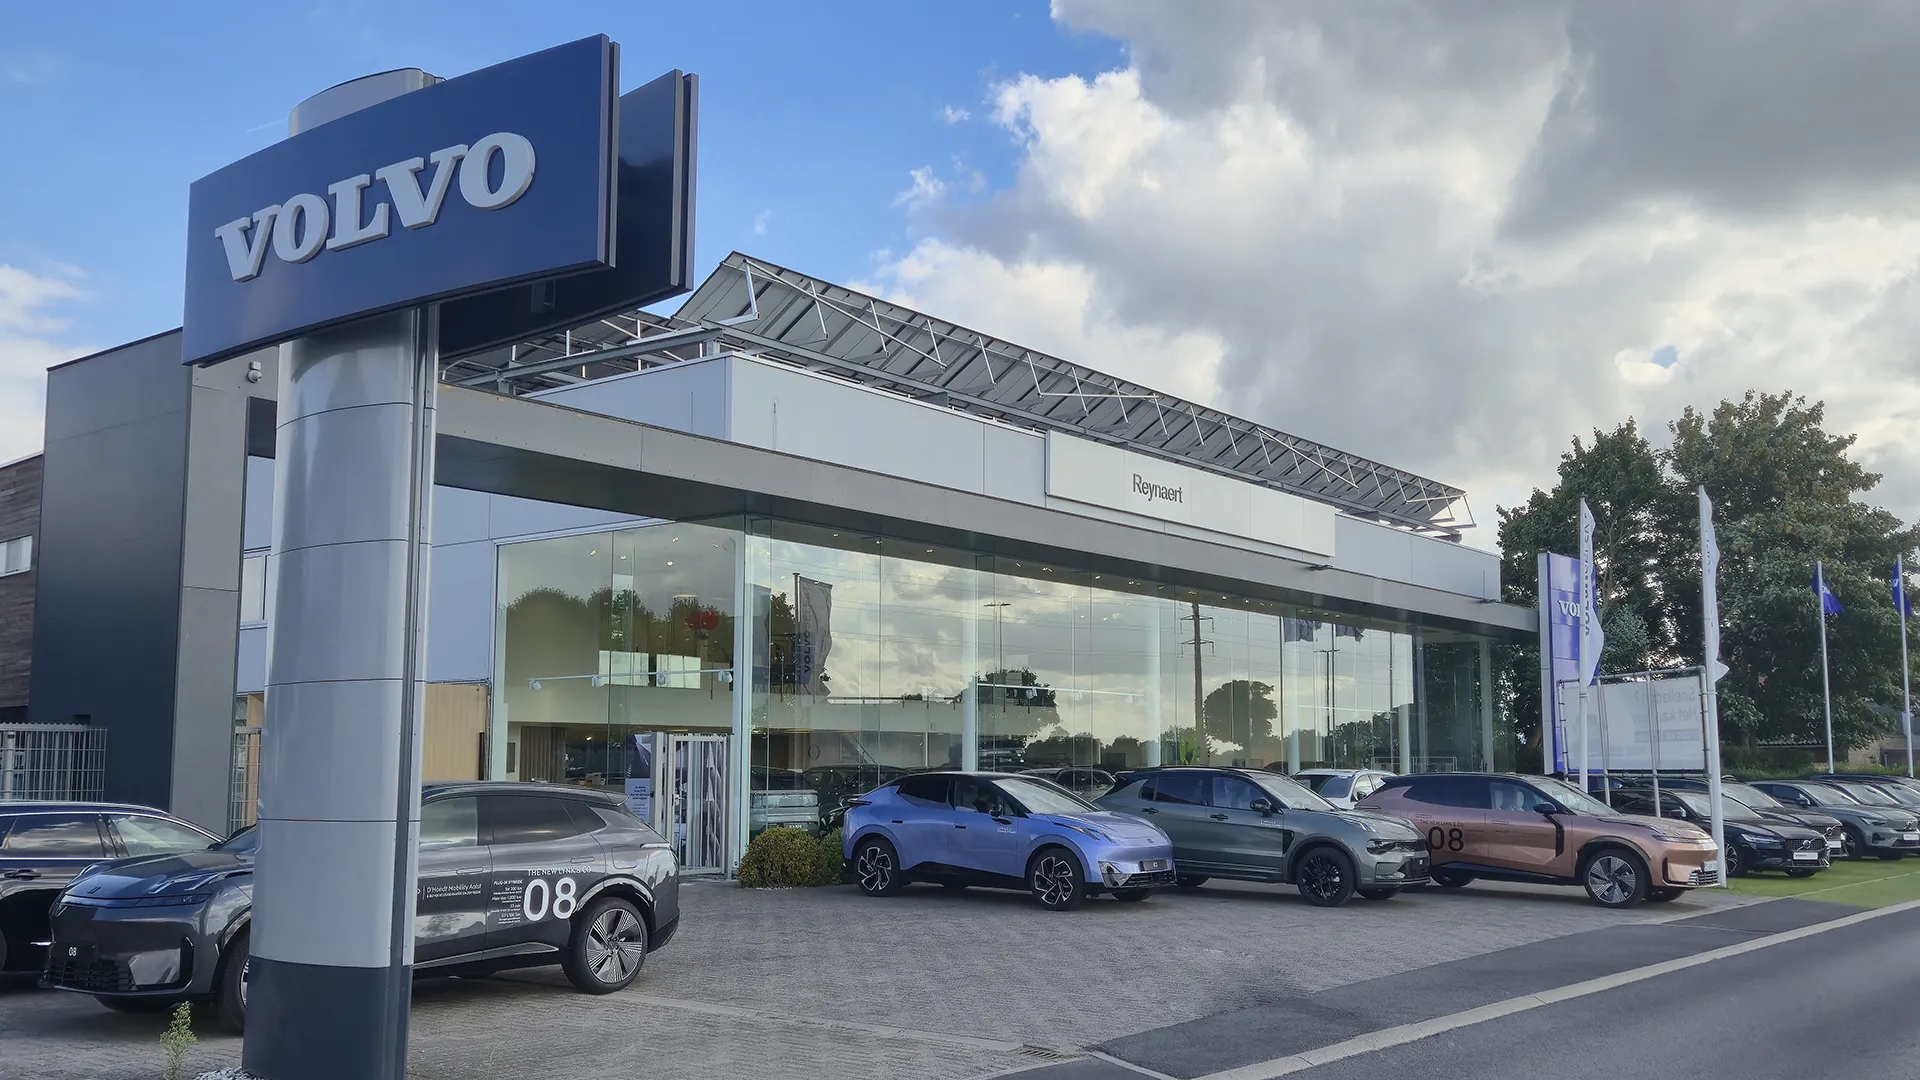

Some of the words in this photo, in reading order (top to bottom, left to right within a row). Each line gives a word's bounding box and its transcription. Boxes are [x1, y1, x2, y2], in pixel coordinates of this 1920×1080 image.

[214, 131, 536, 283] VOLVO
[1132, 473, 1183, 504] Reynaert
[1428, 826, 1464, 852] 08
[528, 869, 541, 877] THE
[541, 868, 558, 876] NEW
[558, 867, 575, 875] LYNK
[523, 877, 577, 922] 08
[68, 946, 77, 957] 08
